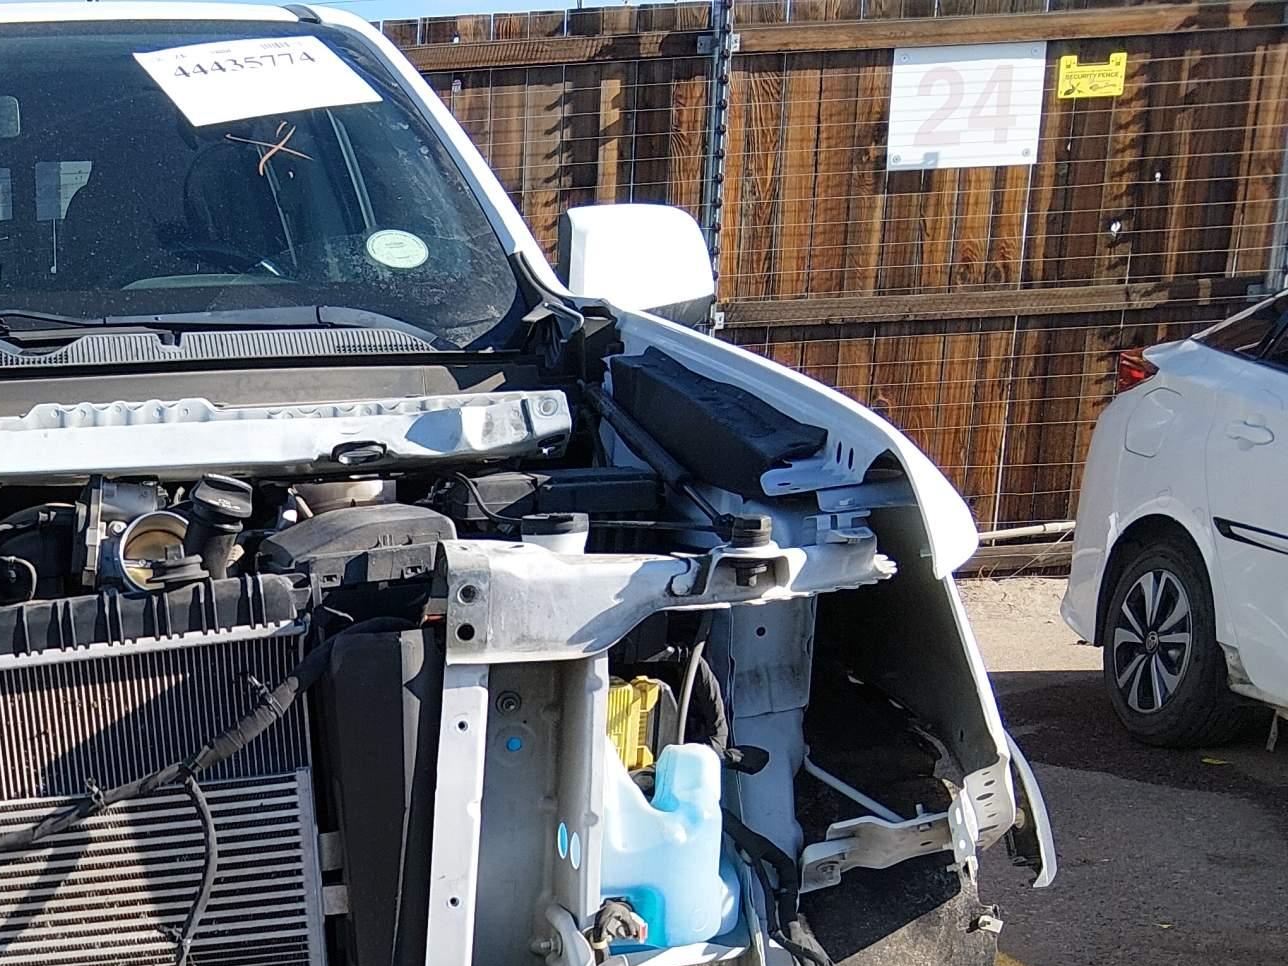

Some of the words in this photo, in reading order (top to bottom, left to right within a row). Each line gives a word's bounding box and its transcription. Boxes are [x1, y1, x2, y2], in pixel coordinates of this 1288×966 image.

[174, 51, 316, 78] 44435774
[1098, 71, 1119, 79] FENCE
[914, 63, 1016, 145] 24
